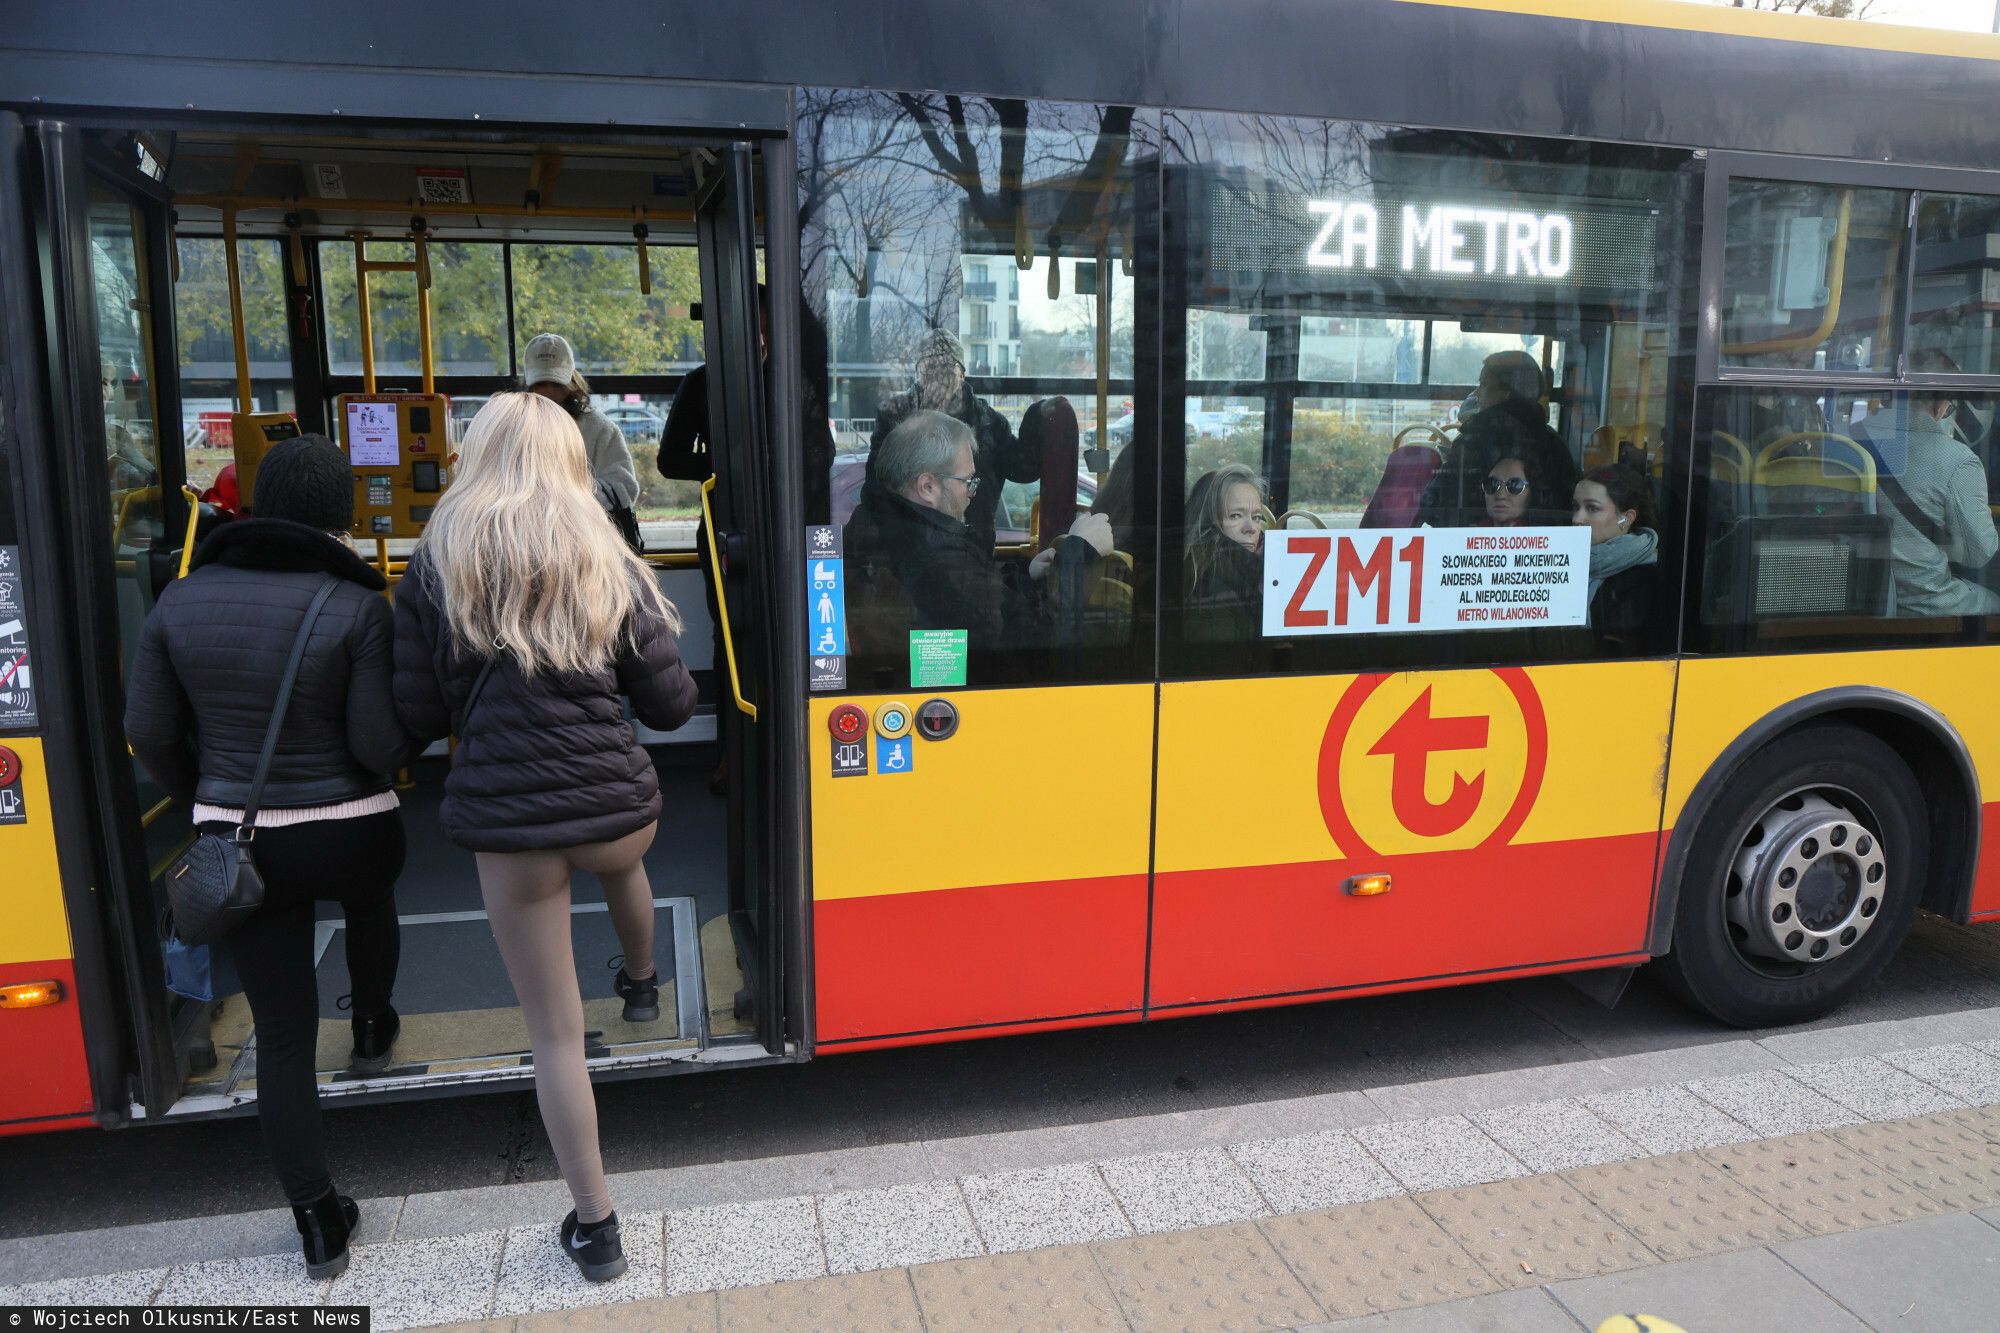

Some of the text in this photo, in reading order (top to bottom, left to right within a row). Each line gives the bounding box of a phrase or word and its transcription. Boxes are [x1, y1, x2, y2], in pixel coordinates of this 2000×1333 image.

[1307, 200, 1572, 278] ZA METRO
[1466, 536, 1549, 550] METRO SŁODOWIEC
[1442, 554, 1570, 569] SŁOWACKIEGO MICKIEWICZA
[1284, 536, 1425, 627] ZM1
[1440, 571, 1570, 586] ANDERSA MARSZAŁKOWSKA
[1459, 587, 1550, 603] AL. NIEPODLEGŁOŚCI
[1457, 606, 1549, 621] METRO WILANOWSKA
